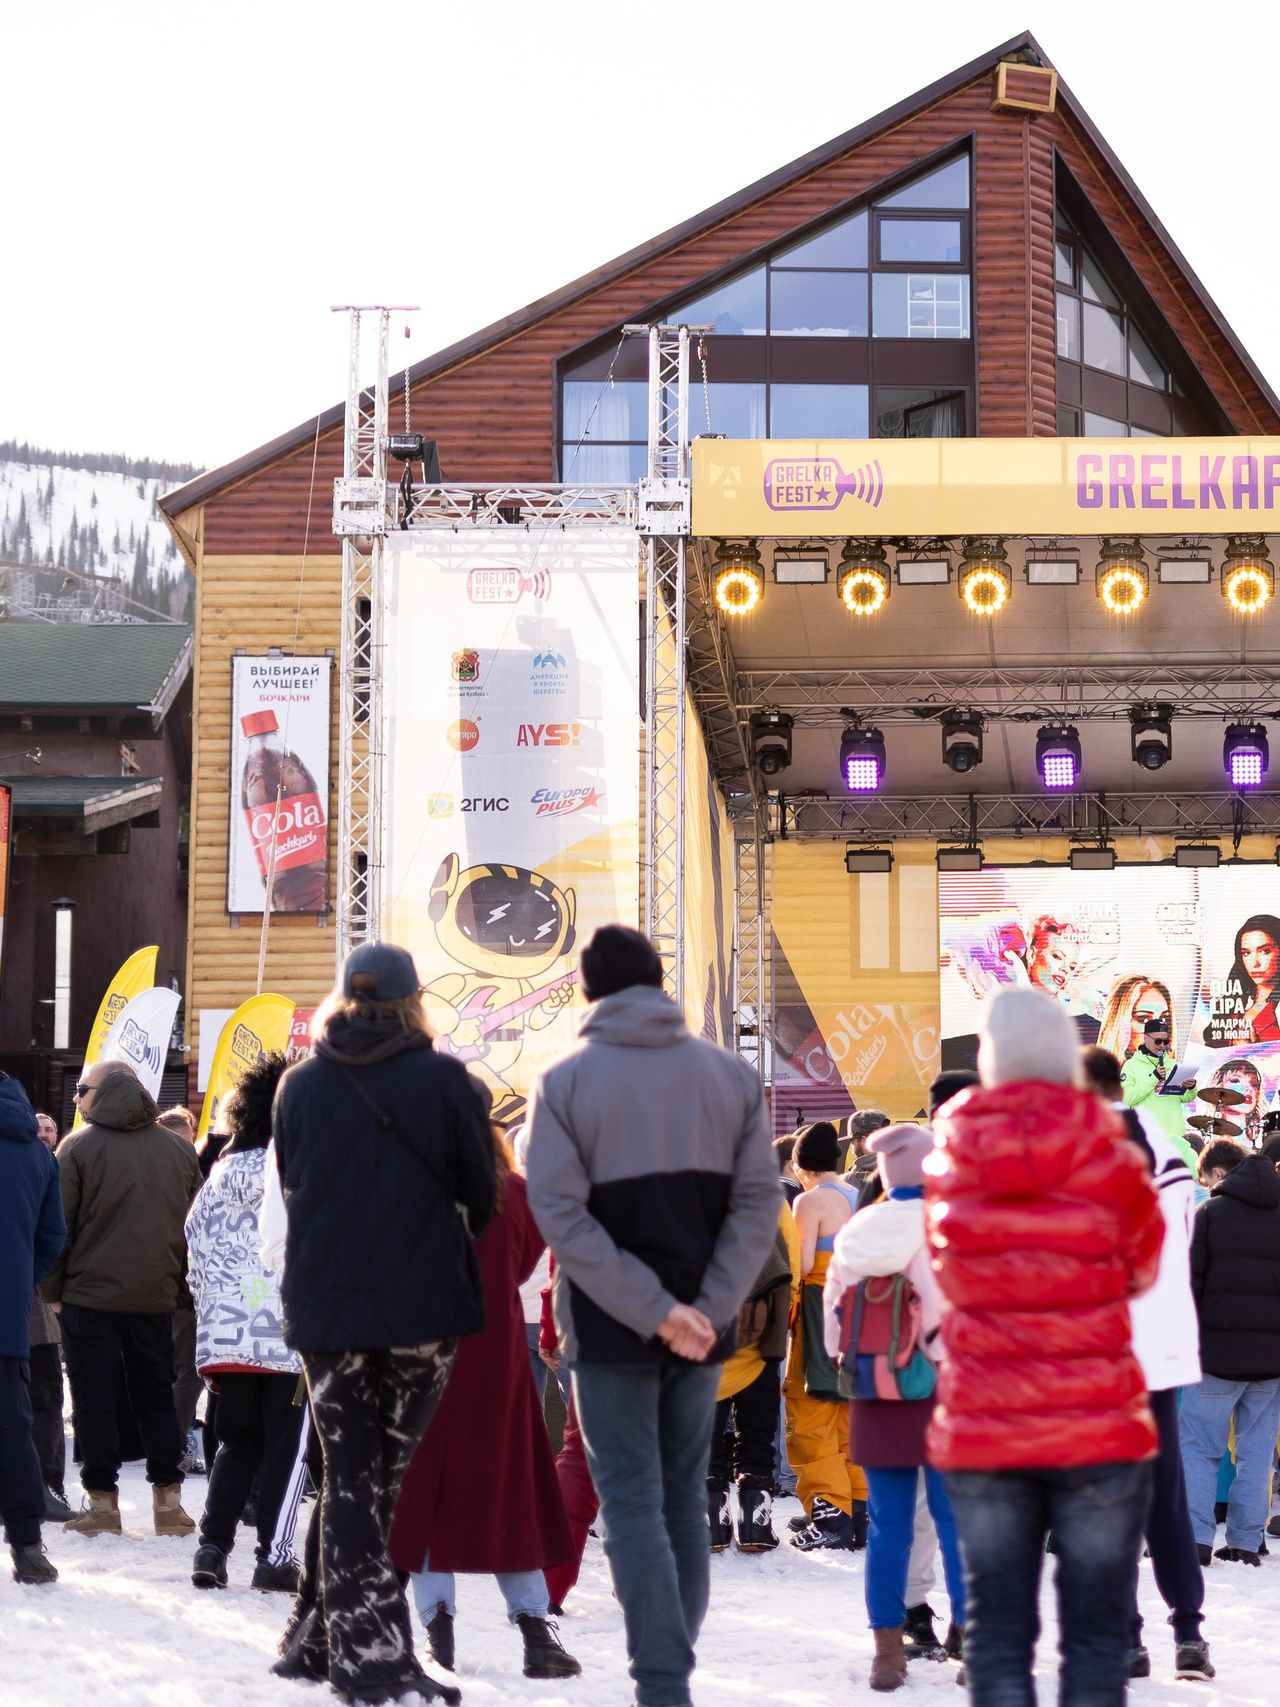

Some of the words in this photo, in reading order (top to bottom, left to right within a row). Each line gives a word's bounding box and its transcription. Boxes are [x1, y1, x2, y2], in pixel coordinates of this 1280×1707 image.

[775, 465, 832, 483] GRELKA
[776, 486, 814, 503] FEST
[475, 572, 516, 585] GRELKA
[475, 587, 502, 599] FEST
[250, 664, 320, 676] ВЫБИРАЙ
[259, 694, 311, 702] БОЧКАРИ
[516, 723, 580, 747] AYS!
[530, 787, 591, 804] Europa
[460, 797, 510, 812] 2ГИС
[251, 801, 321, 840] Cola
[1210, 997, 1246, 1015] LIPA
[1211, 1018, 1252, 1031] МАДРИД
[805, 1004, 878, 1082] Cola
[1211, 1030, 1222, 1040] 10
[1223, 1030, 1250, 1040] ИЮЛЯ
[234, 1039, 250, 1057] FEST
